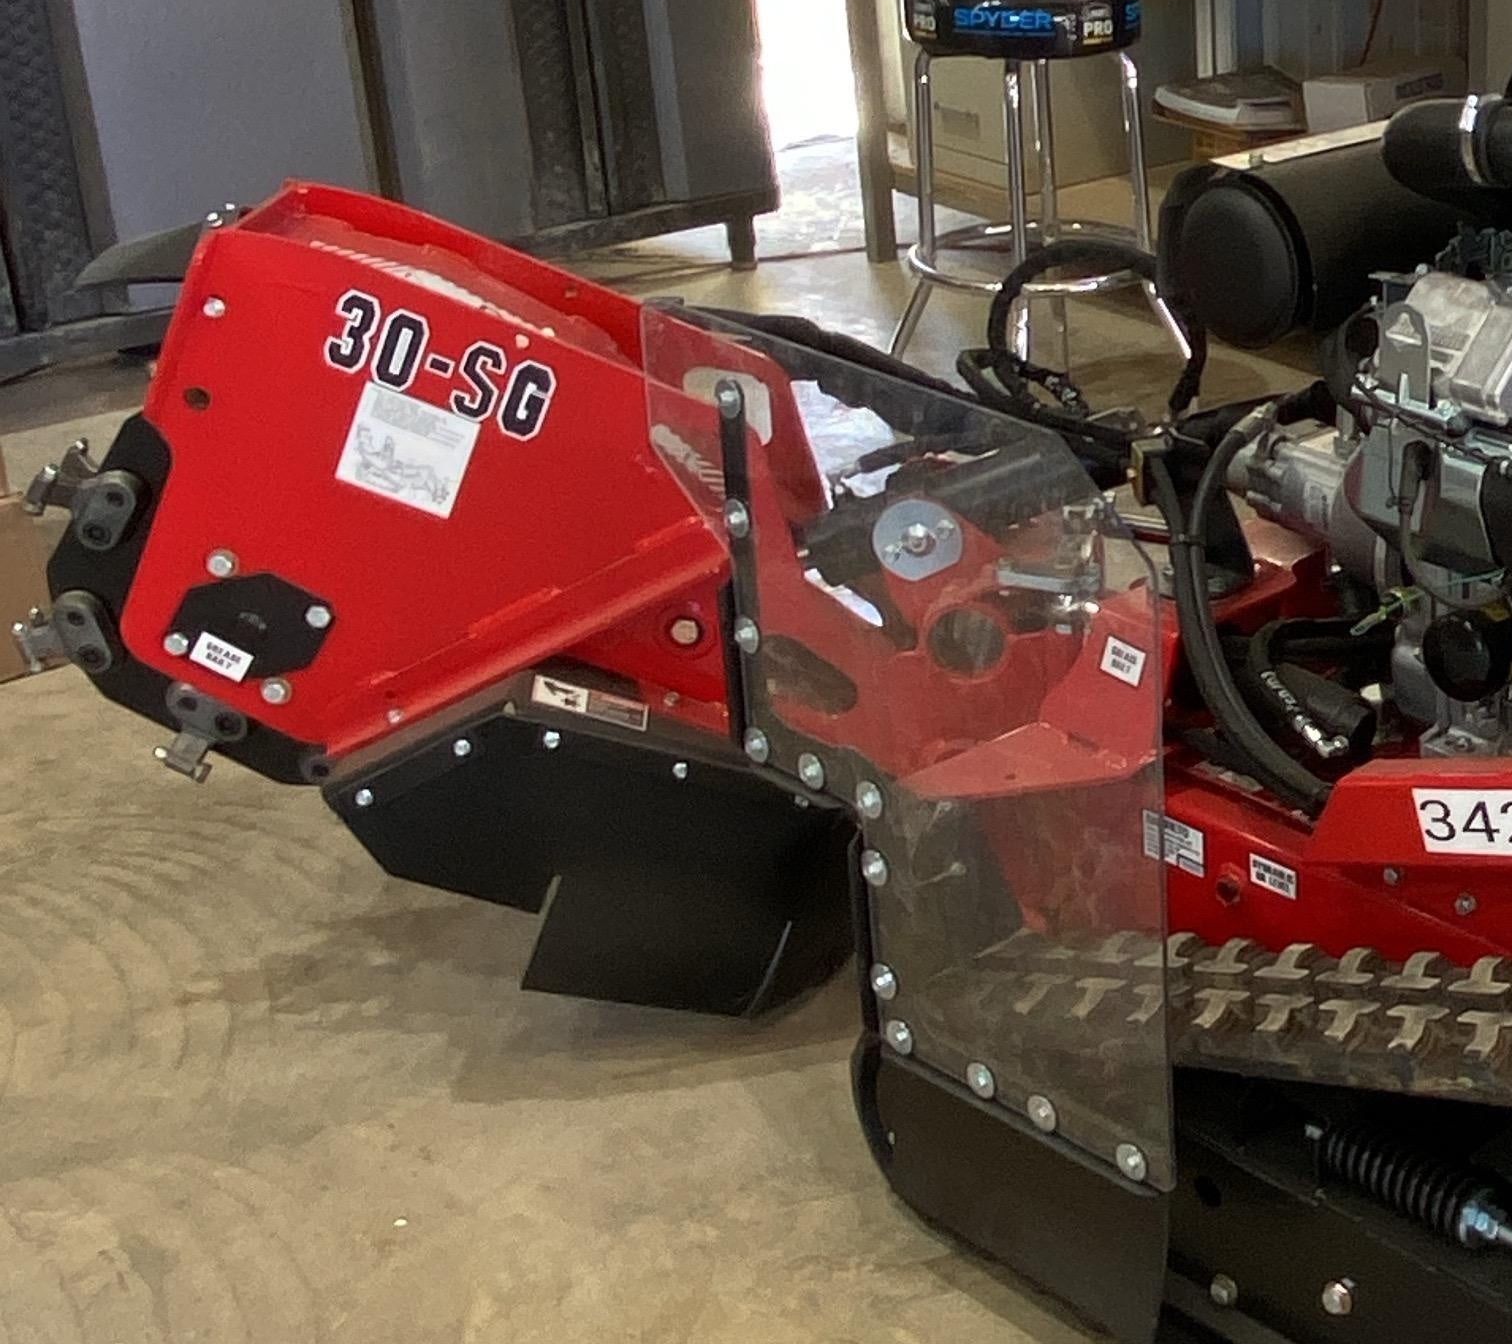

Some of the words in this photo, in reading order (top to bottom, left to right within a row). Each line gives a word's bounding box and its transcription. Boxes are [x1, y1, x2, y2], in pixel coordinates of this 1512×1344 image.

[913, 15, 936, 32] PRO
[954, 8, 1053, 30] SPYDER
[1083, 21, 1113, 36] PRO
[324, 289, 557, 442] 30-SG
